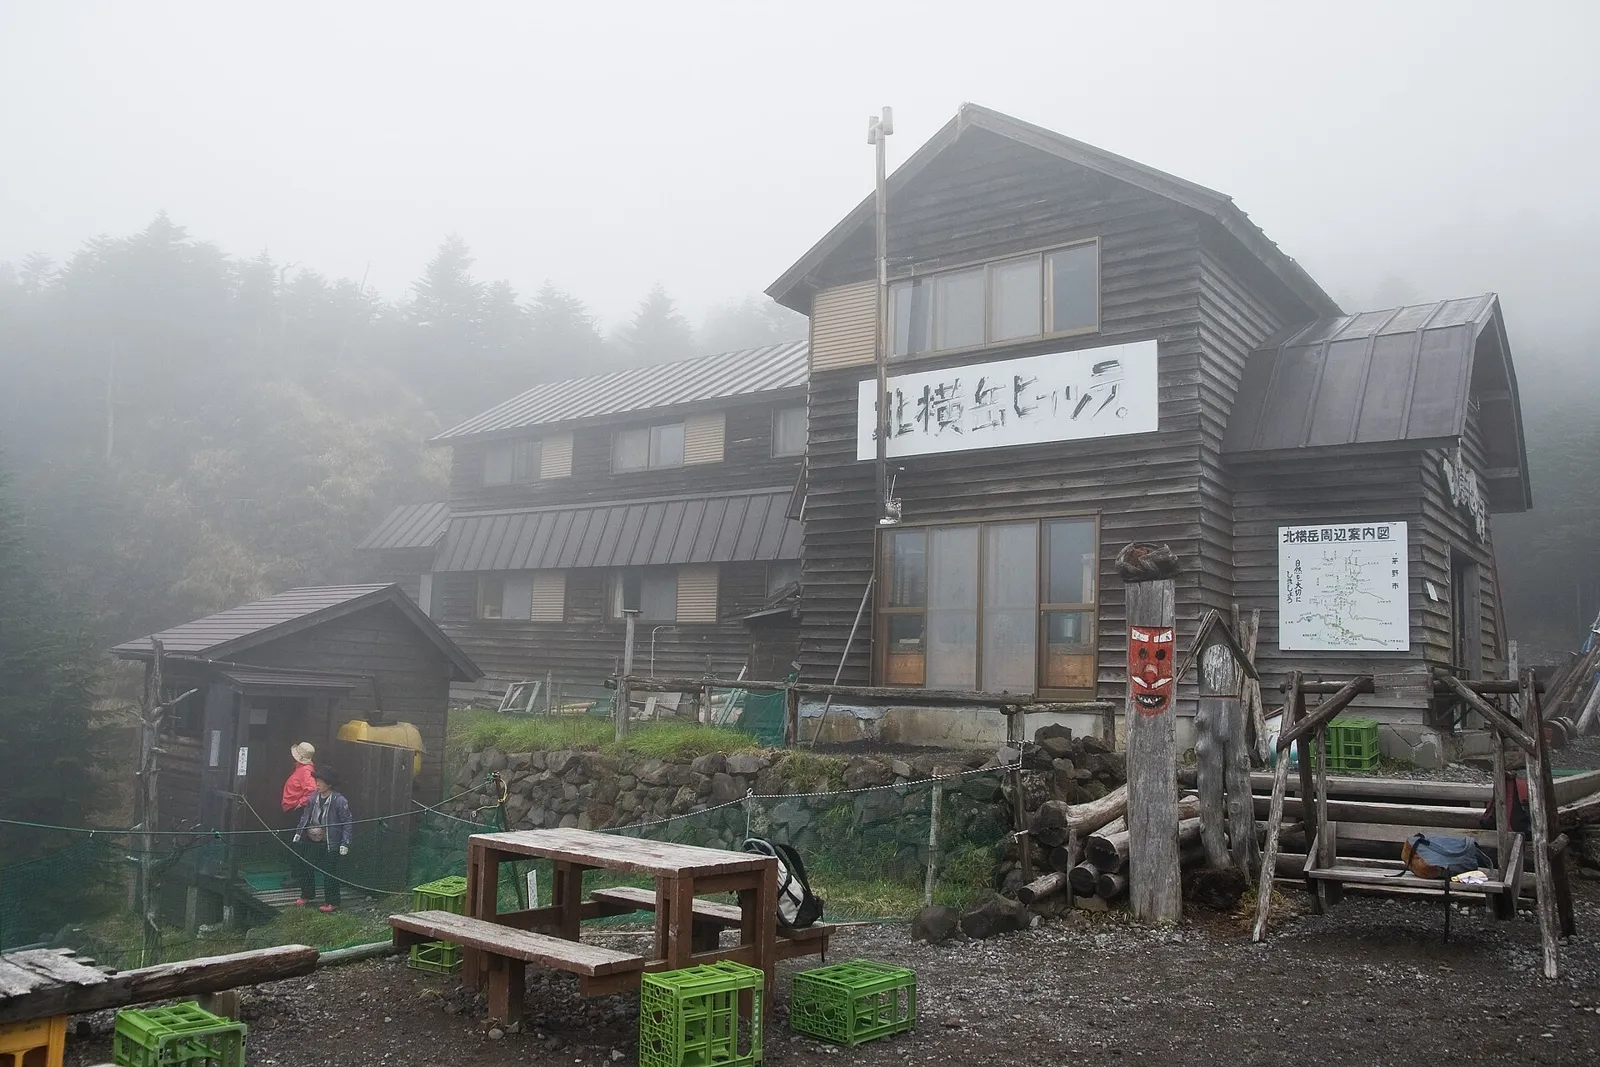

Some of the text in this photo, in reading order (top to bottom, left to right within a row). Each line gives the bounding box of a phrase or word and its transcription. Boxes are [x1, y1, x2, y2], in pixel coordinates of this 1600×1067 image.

[1283, 526, 1390, 543] 北横岳周辺案内図
